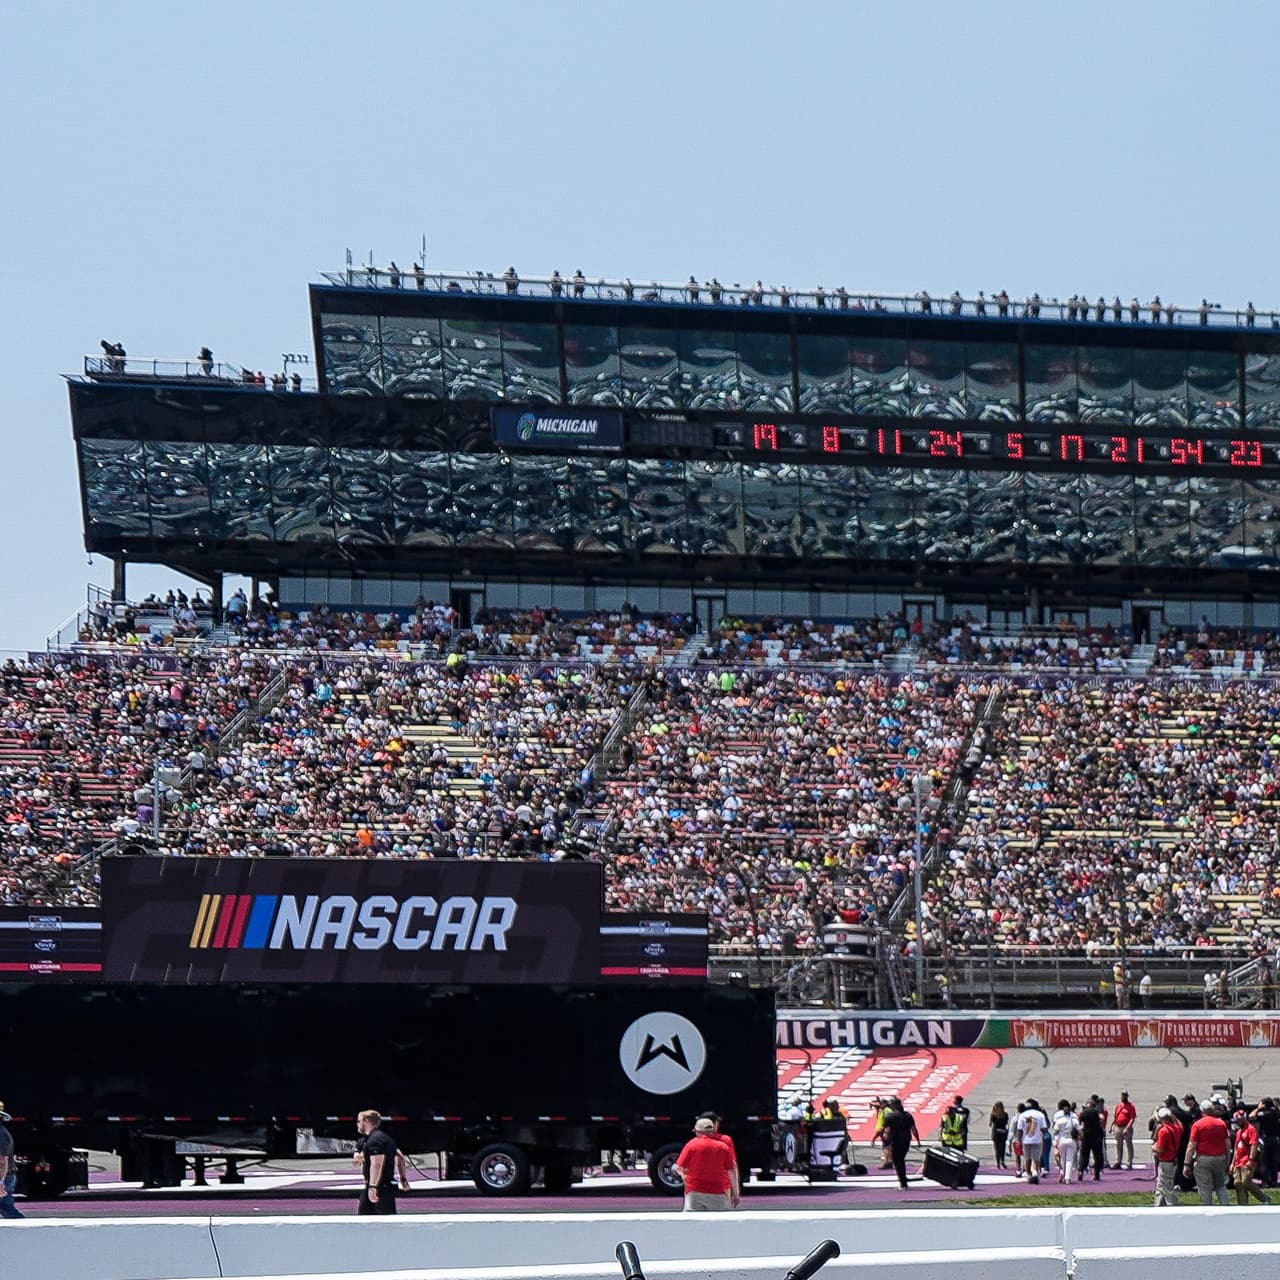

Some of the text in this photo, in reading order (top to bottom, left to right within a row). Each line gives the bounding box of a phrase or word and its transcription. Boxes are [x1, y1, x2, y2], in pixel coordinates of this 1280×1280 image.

[536, 418, 599, 433] MICHIGAN
[753, 424, 778, 450] 19
[823, 426, 840, 453] 8
[877, 428, 902, 455] 11
[929, 429, 963, 457] 24
[1007, 432, 1024, 459] 5
[1111, 436, 1145, 464] 21
[1170, 438, 1203, 465] 54
[1230, 440, 1262, 467] 23
[269, 895, 518, 951] NASCAR
[1053, 1022, 1122, 1037] FIREKEEPERS
[1167, 1022, 1234, 1037] FIREKEEPERS
